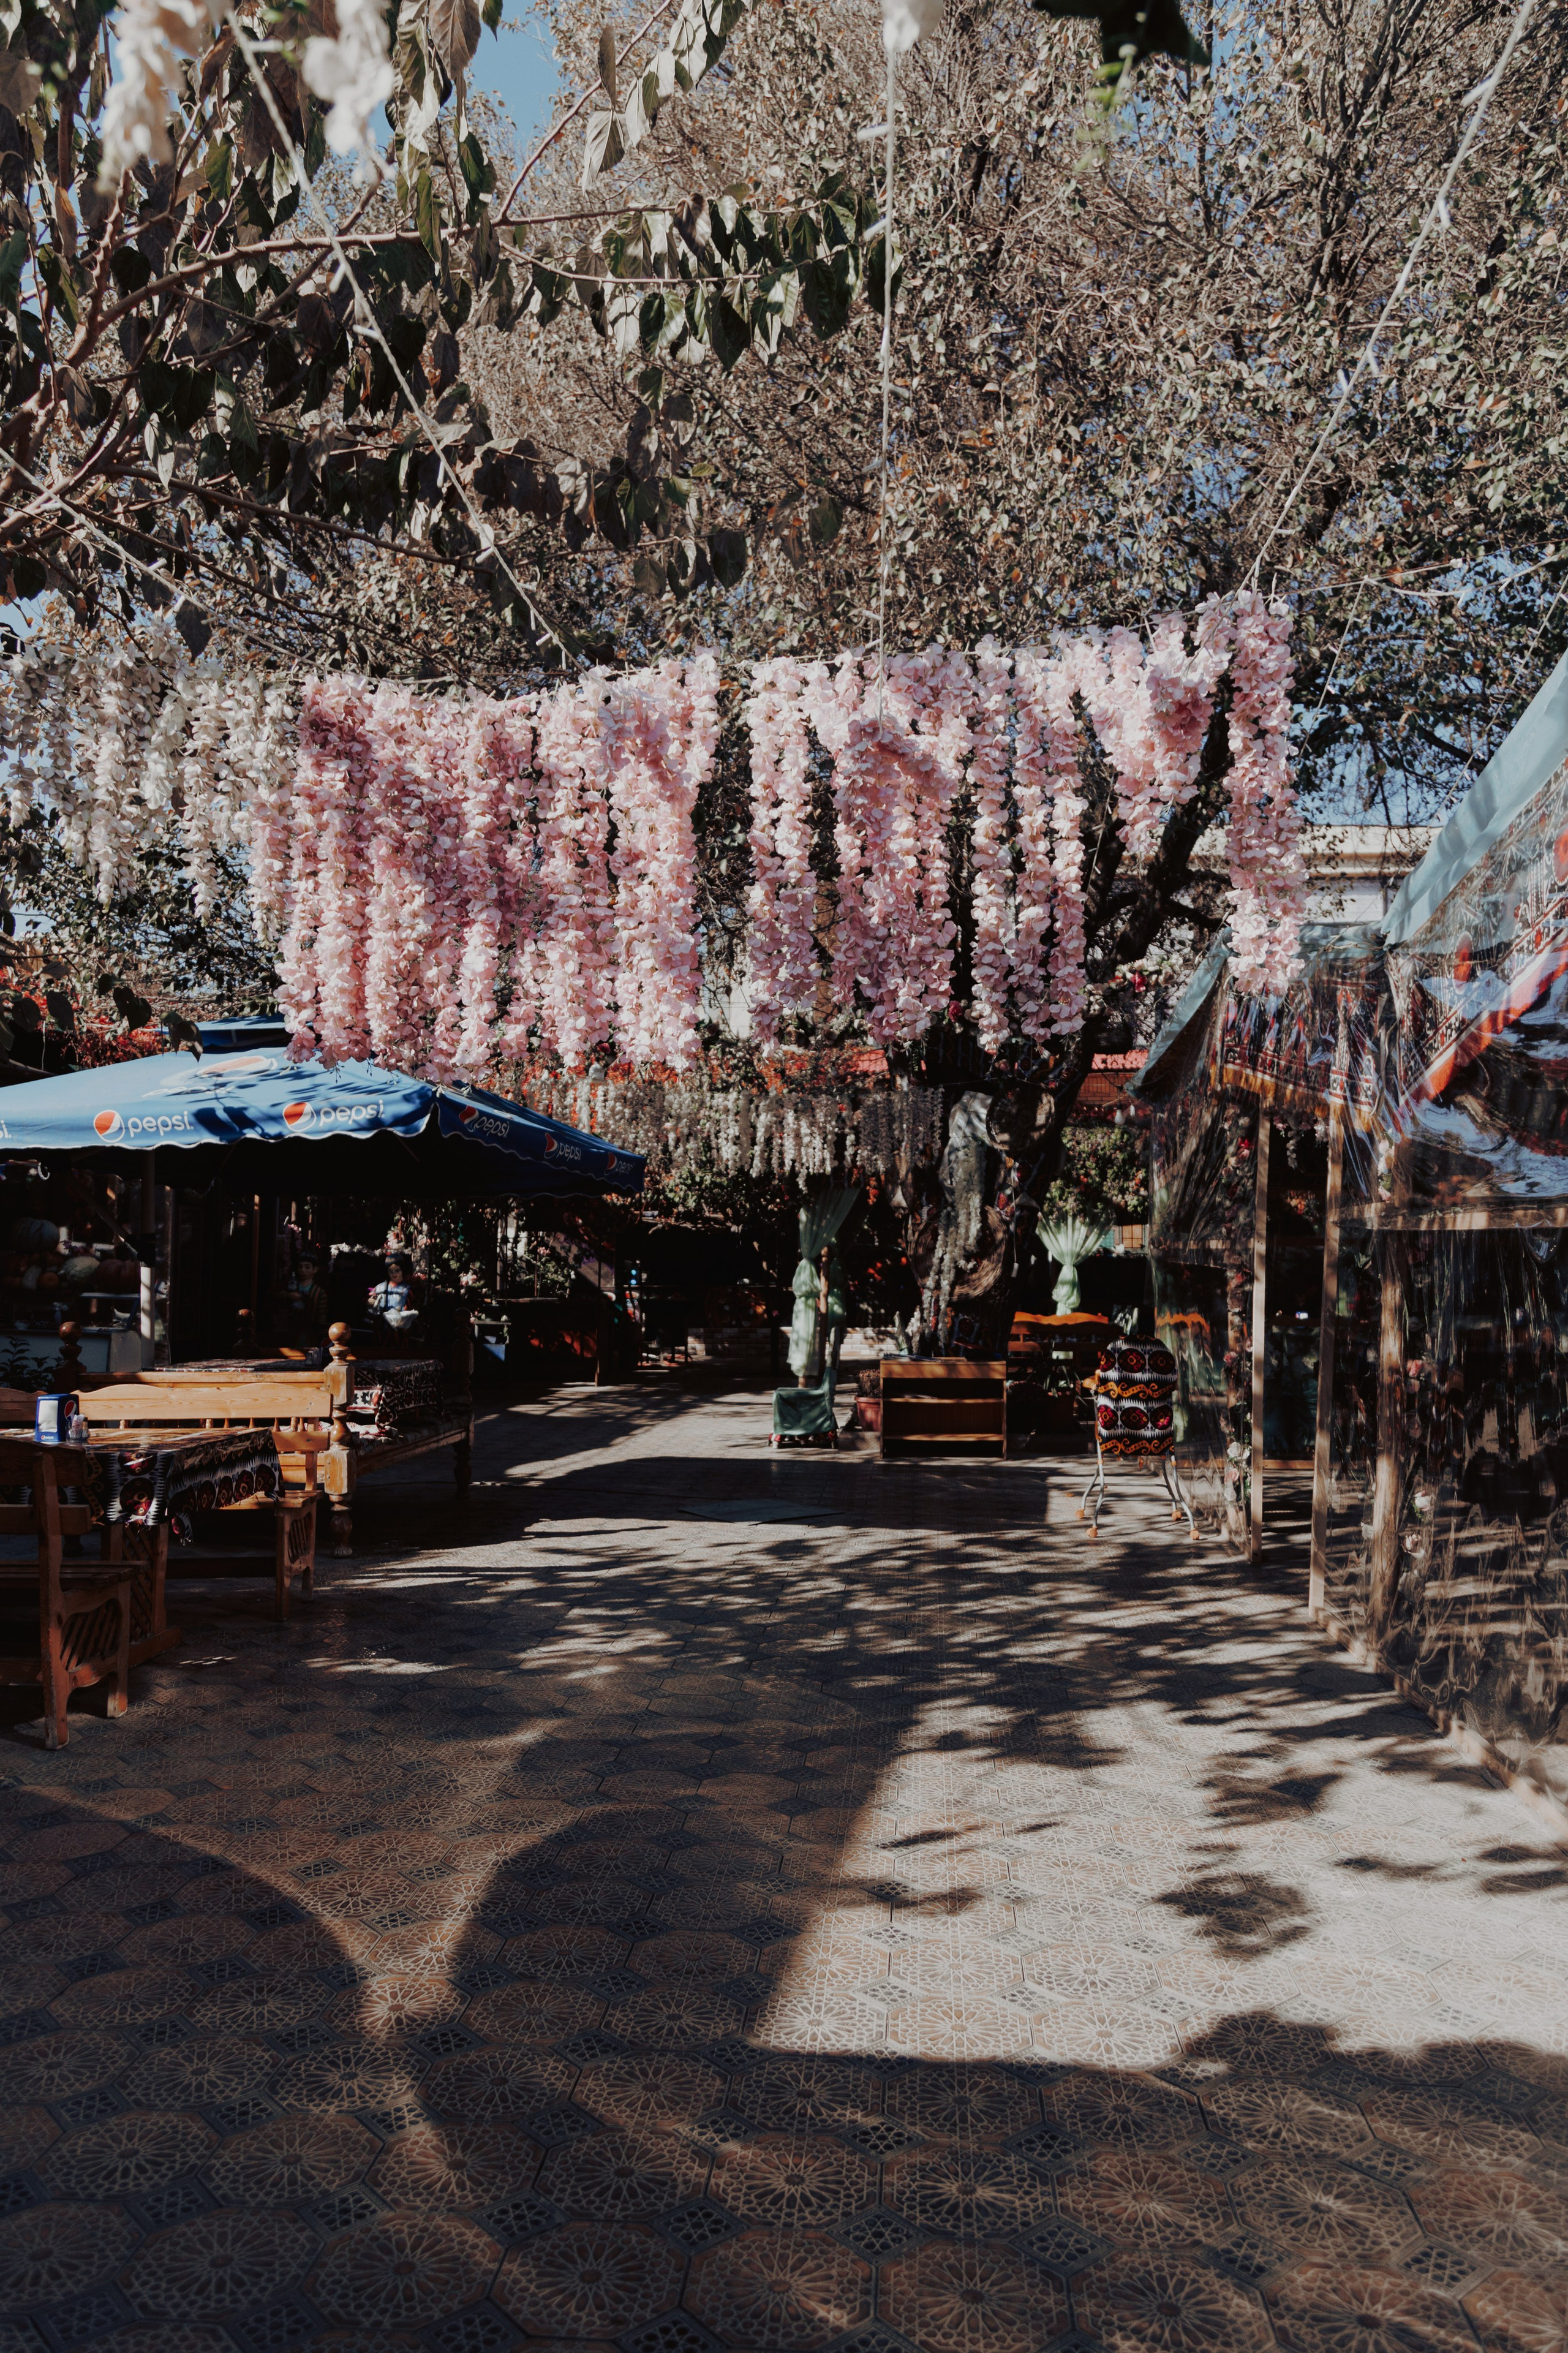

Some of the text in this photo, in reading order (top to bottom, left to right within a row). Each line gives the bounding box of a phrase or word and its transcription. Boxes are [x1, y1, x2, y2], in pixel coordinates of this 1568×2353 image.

[127, 1111, 194, 1138] pepsi
[319, 1099, 385, 1127] pepsi
[473, 1116, 510, 1138] pepsi
[556, 1143, 582, 1161] pepsi
